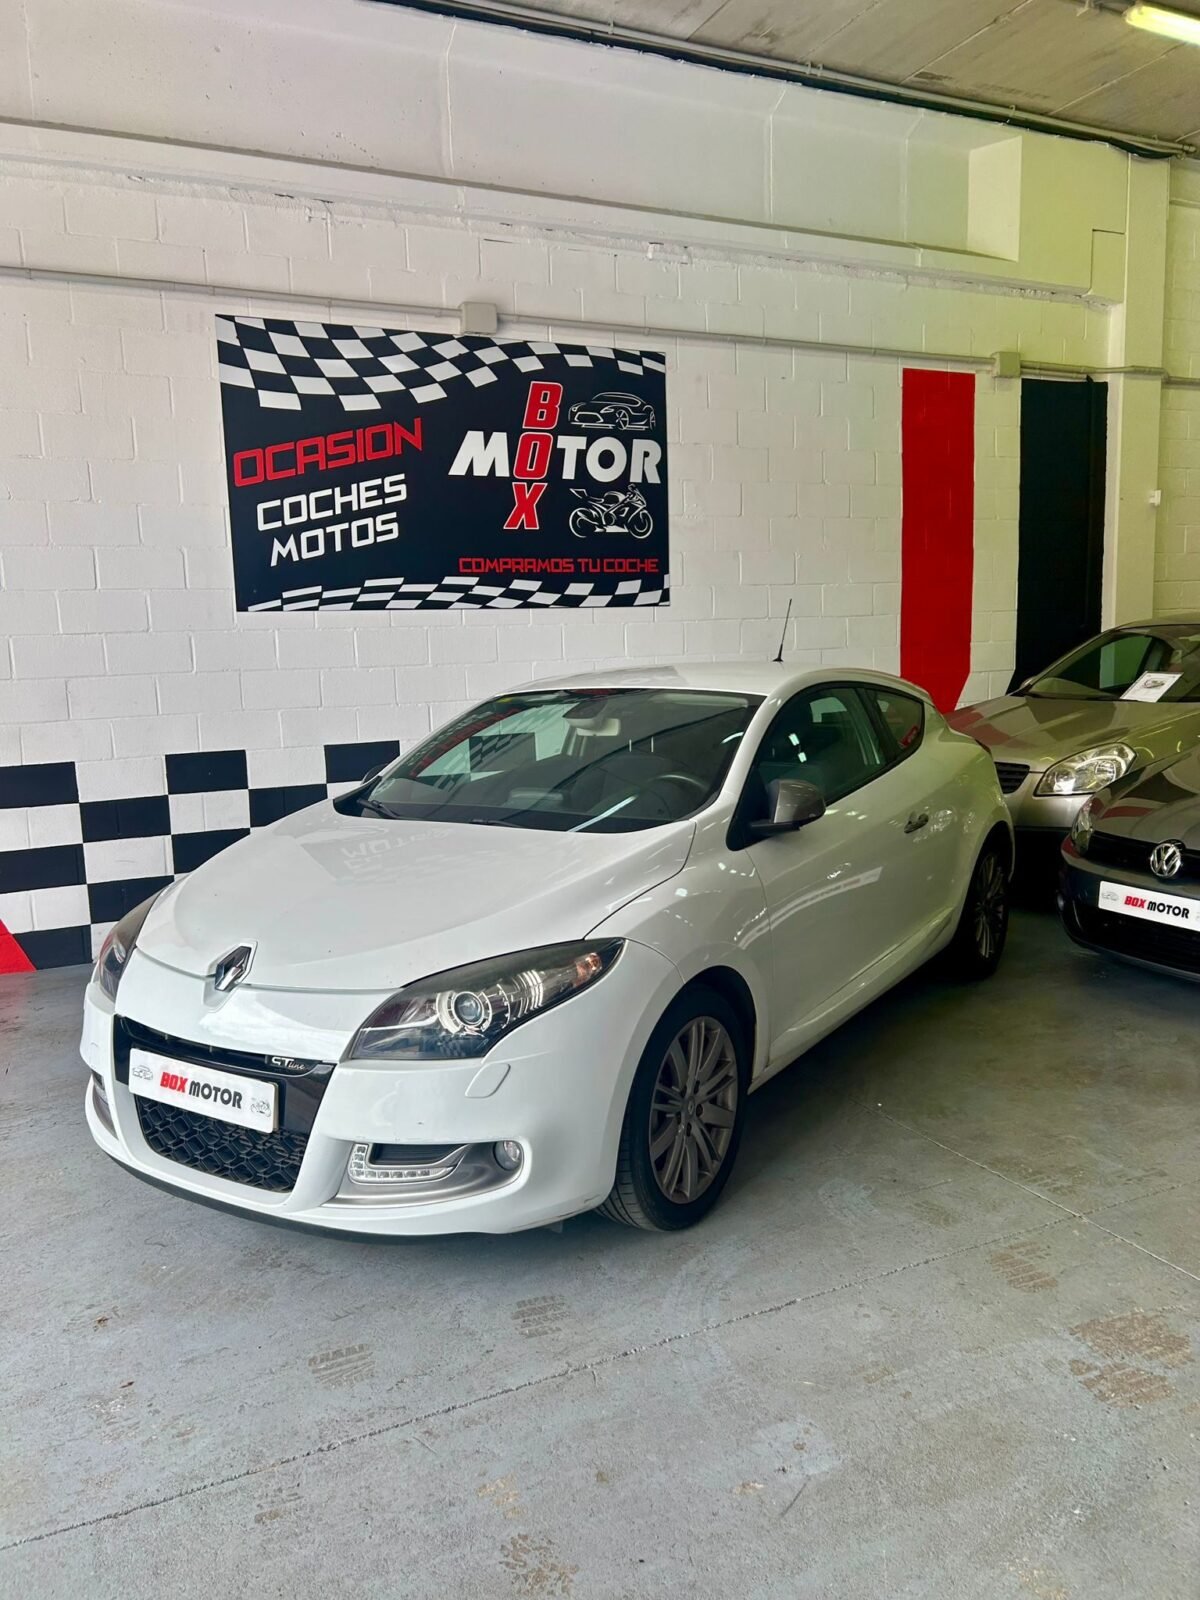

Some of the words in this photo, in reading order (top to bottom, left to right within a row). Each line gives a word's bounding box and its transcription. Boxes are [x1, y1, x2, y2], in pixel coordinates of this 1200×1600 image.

[233, 417, 422, 487] OCASION
[448, 430, 661, 484] MOTOR
[503, 381, 563, 530] BOX
[257, 473, 407, 531] COCHES
[270, 512, 399, 567] MOTOS
[458, 557, 574, 573] COMPRAMOS
[577, 557, 600, 573] TU
[603, 557, 659, 573] COCHE
[1124, 896, 1146, 909] BOX
[1147, 901, 1190, 919] MOTOR
[160, 1071, 188, 1093] BOX
[189, 1080, 242, 1109] MOTOR
